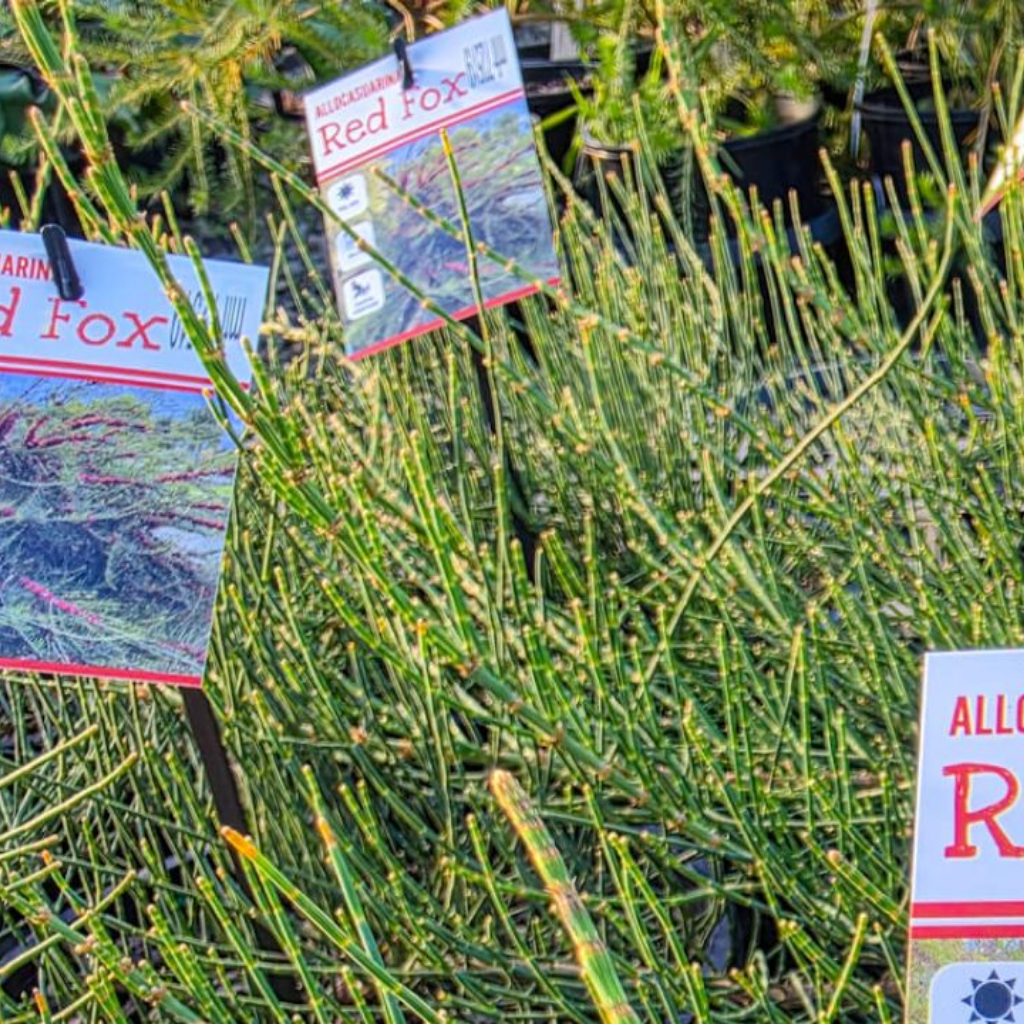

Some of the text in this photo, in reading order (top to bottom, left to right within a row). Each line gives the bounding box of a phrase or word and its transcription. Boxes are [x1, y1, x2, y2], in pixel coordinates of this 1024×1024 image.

[317, 72, 468, 156] Red Fox
[39, 296, 169, 350] Fox
